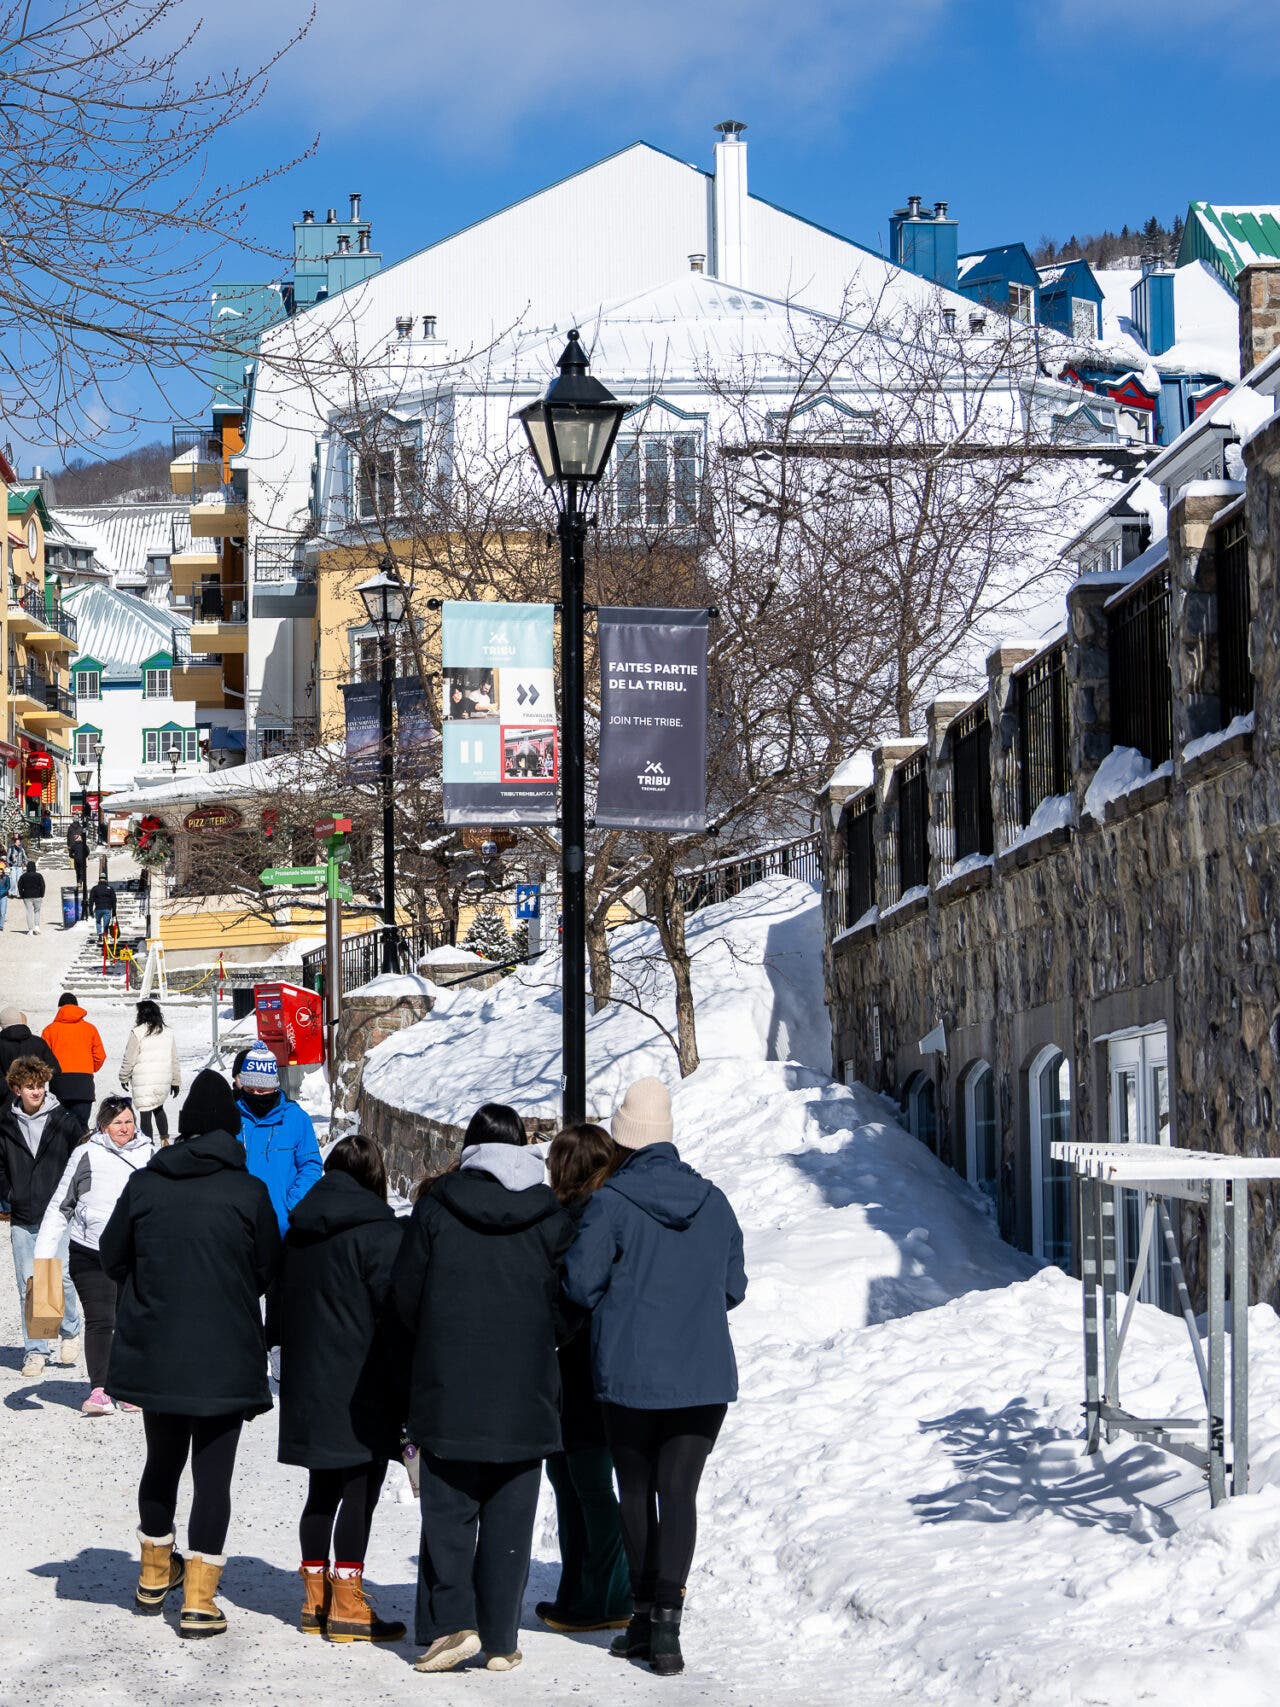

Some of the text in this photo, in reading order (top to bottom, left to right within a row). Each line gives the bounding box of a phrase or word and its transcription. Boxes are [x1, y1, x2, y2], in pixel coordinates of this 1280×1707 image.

[482, 646, 516, 655] TRIBU
[608, 662, 698, 675] FAITES PARTIE
[609, 679, 687, 692] DE LA TRIBU.
[608, 715, 684, 727] JOIN THE TRIBE.
[637, 775, 671, 786] TRIBU
